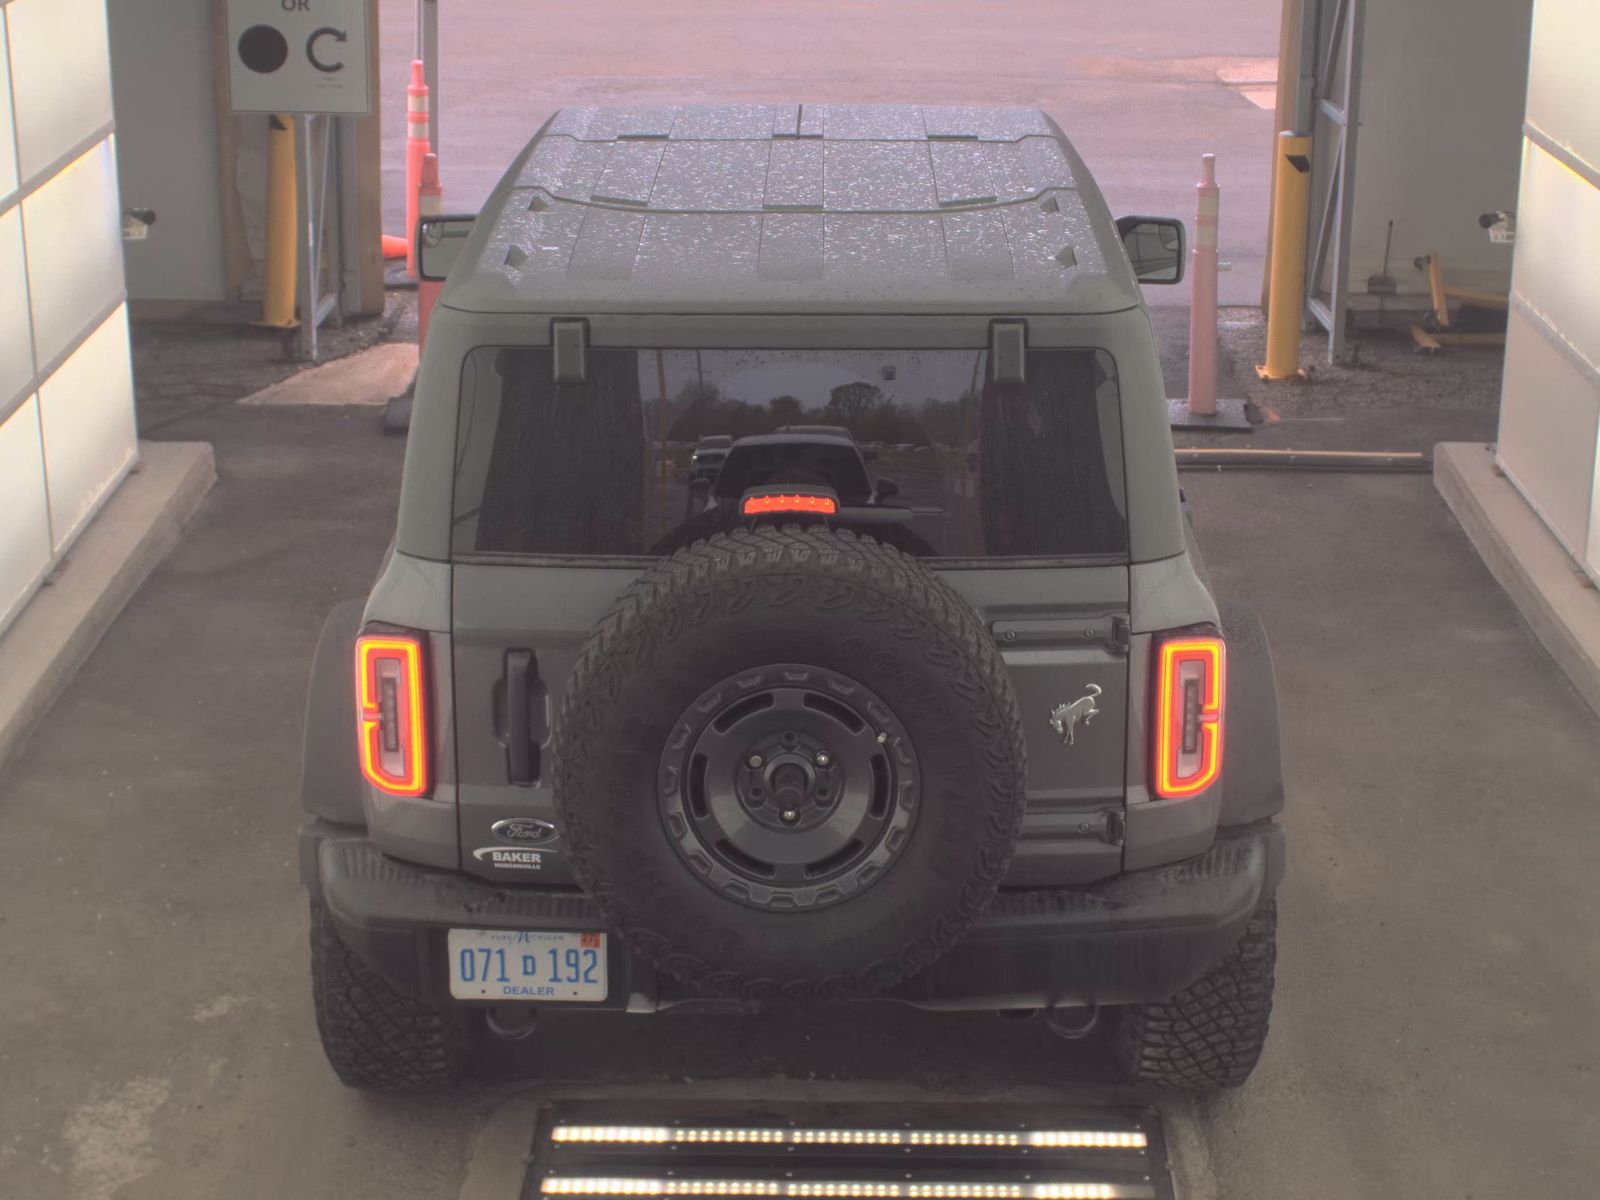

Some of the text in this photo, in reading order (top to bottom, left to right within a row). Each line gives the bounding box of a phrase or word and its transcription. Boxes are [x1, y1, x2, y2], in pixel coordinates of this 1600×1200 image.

[281, 0, 310, 12] OR
[507, 823, 542, 839] Ford
[492, 851, 541, 863] BAKER
[460, 948, 598, 983] 071 D 192
[503, 986, 554, 996] DEALER
